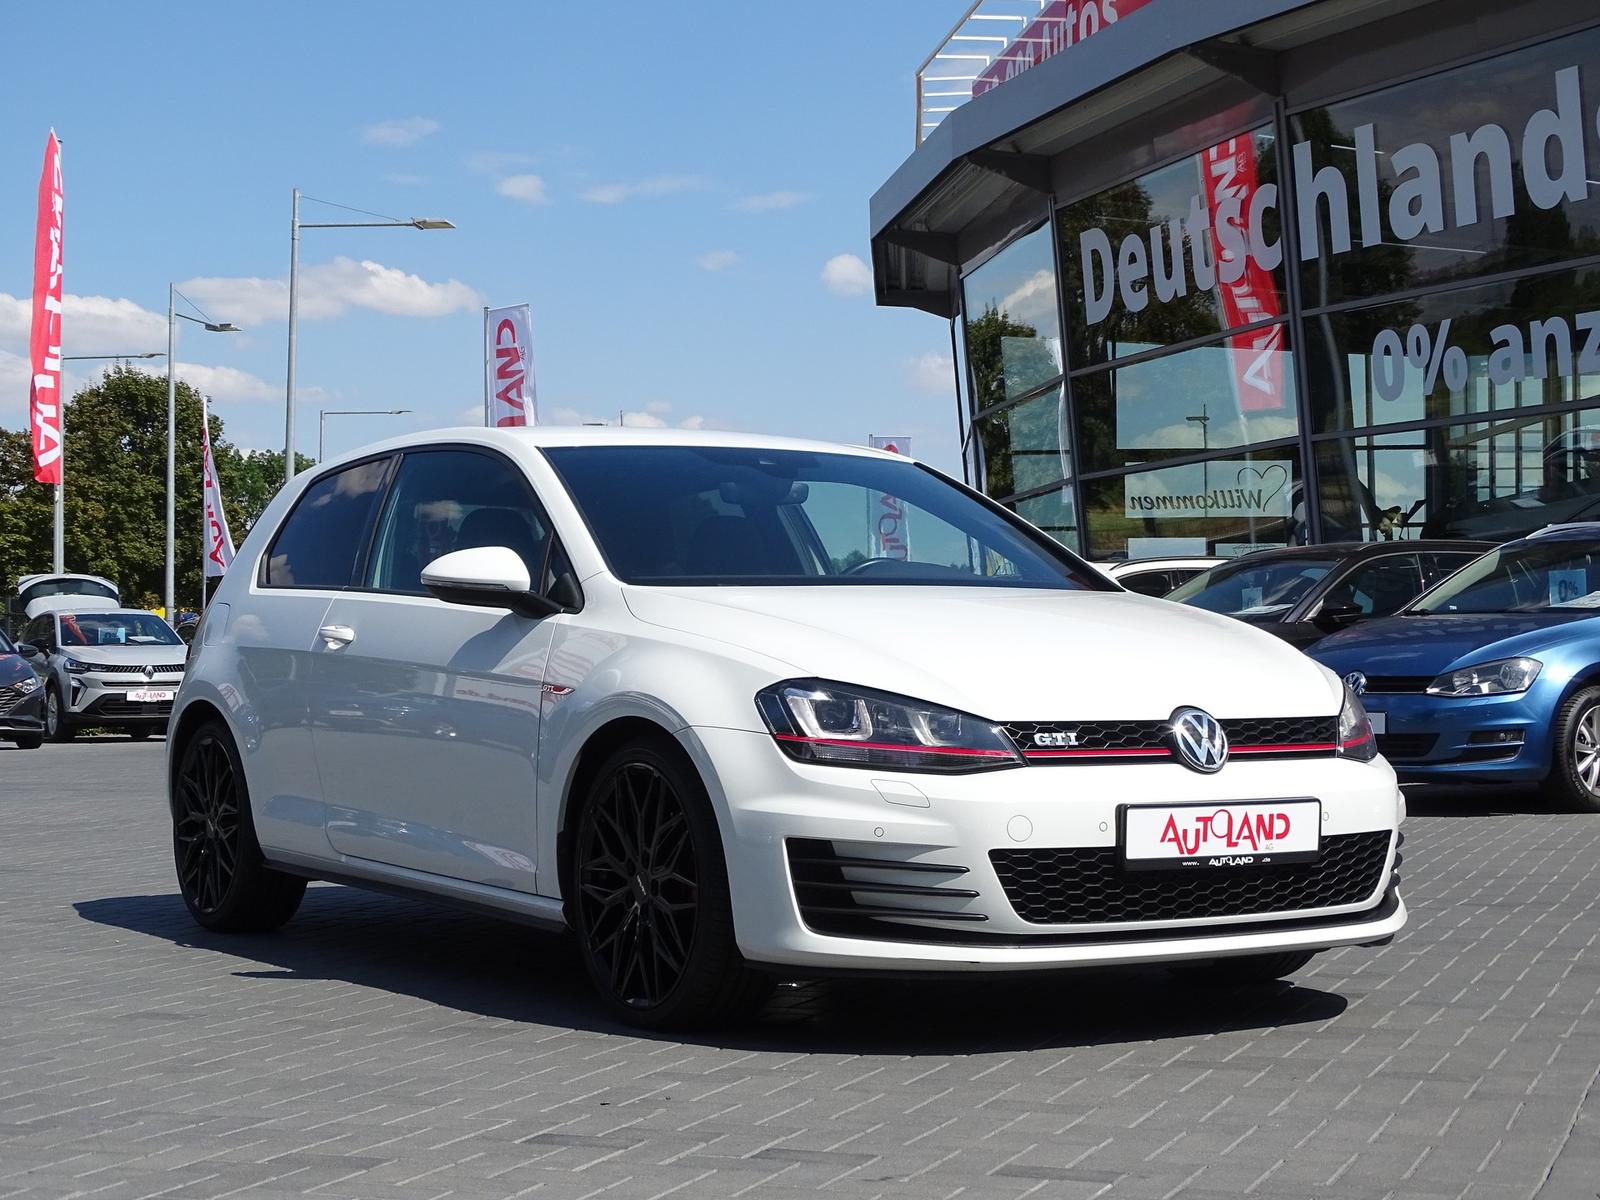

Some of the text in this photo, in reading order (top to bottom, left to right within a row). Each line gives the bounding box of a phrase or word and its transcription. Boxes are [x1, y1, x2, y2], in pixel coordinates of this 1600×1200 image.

[1080, 65, 1600, 326] Deutschland
[1371, 319, 1468, 402] 0%
[135, 692, 166, 700] AUTLAND
[1033, 732, 1079, 746] GTI
[1160, 809, 1290, 855] AUTOLAND
[1208, 856, 1253, 866] AUTOLAND
